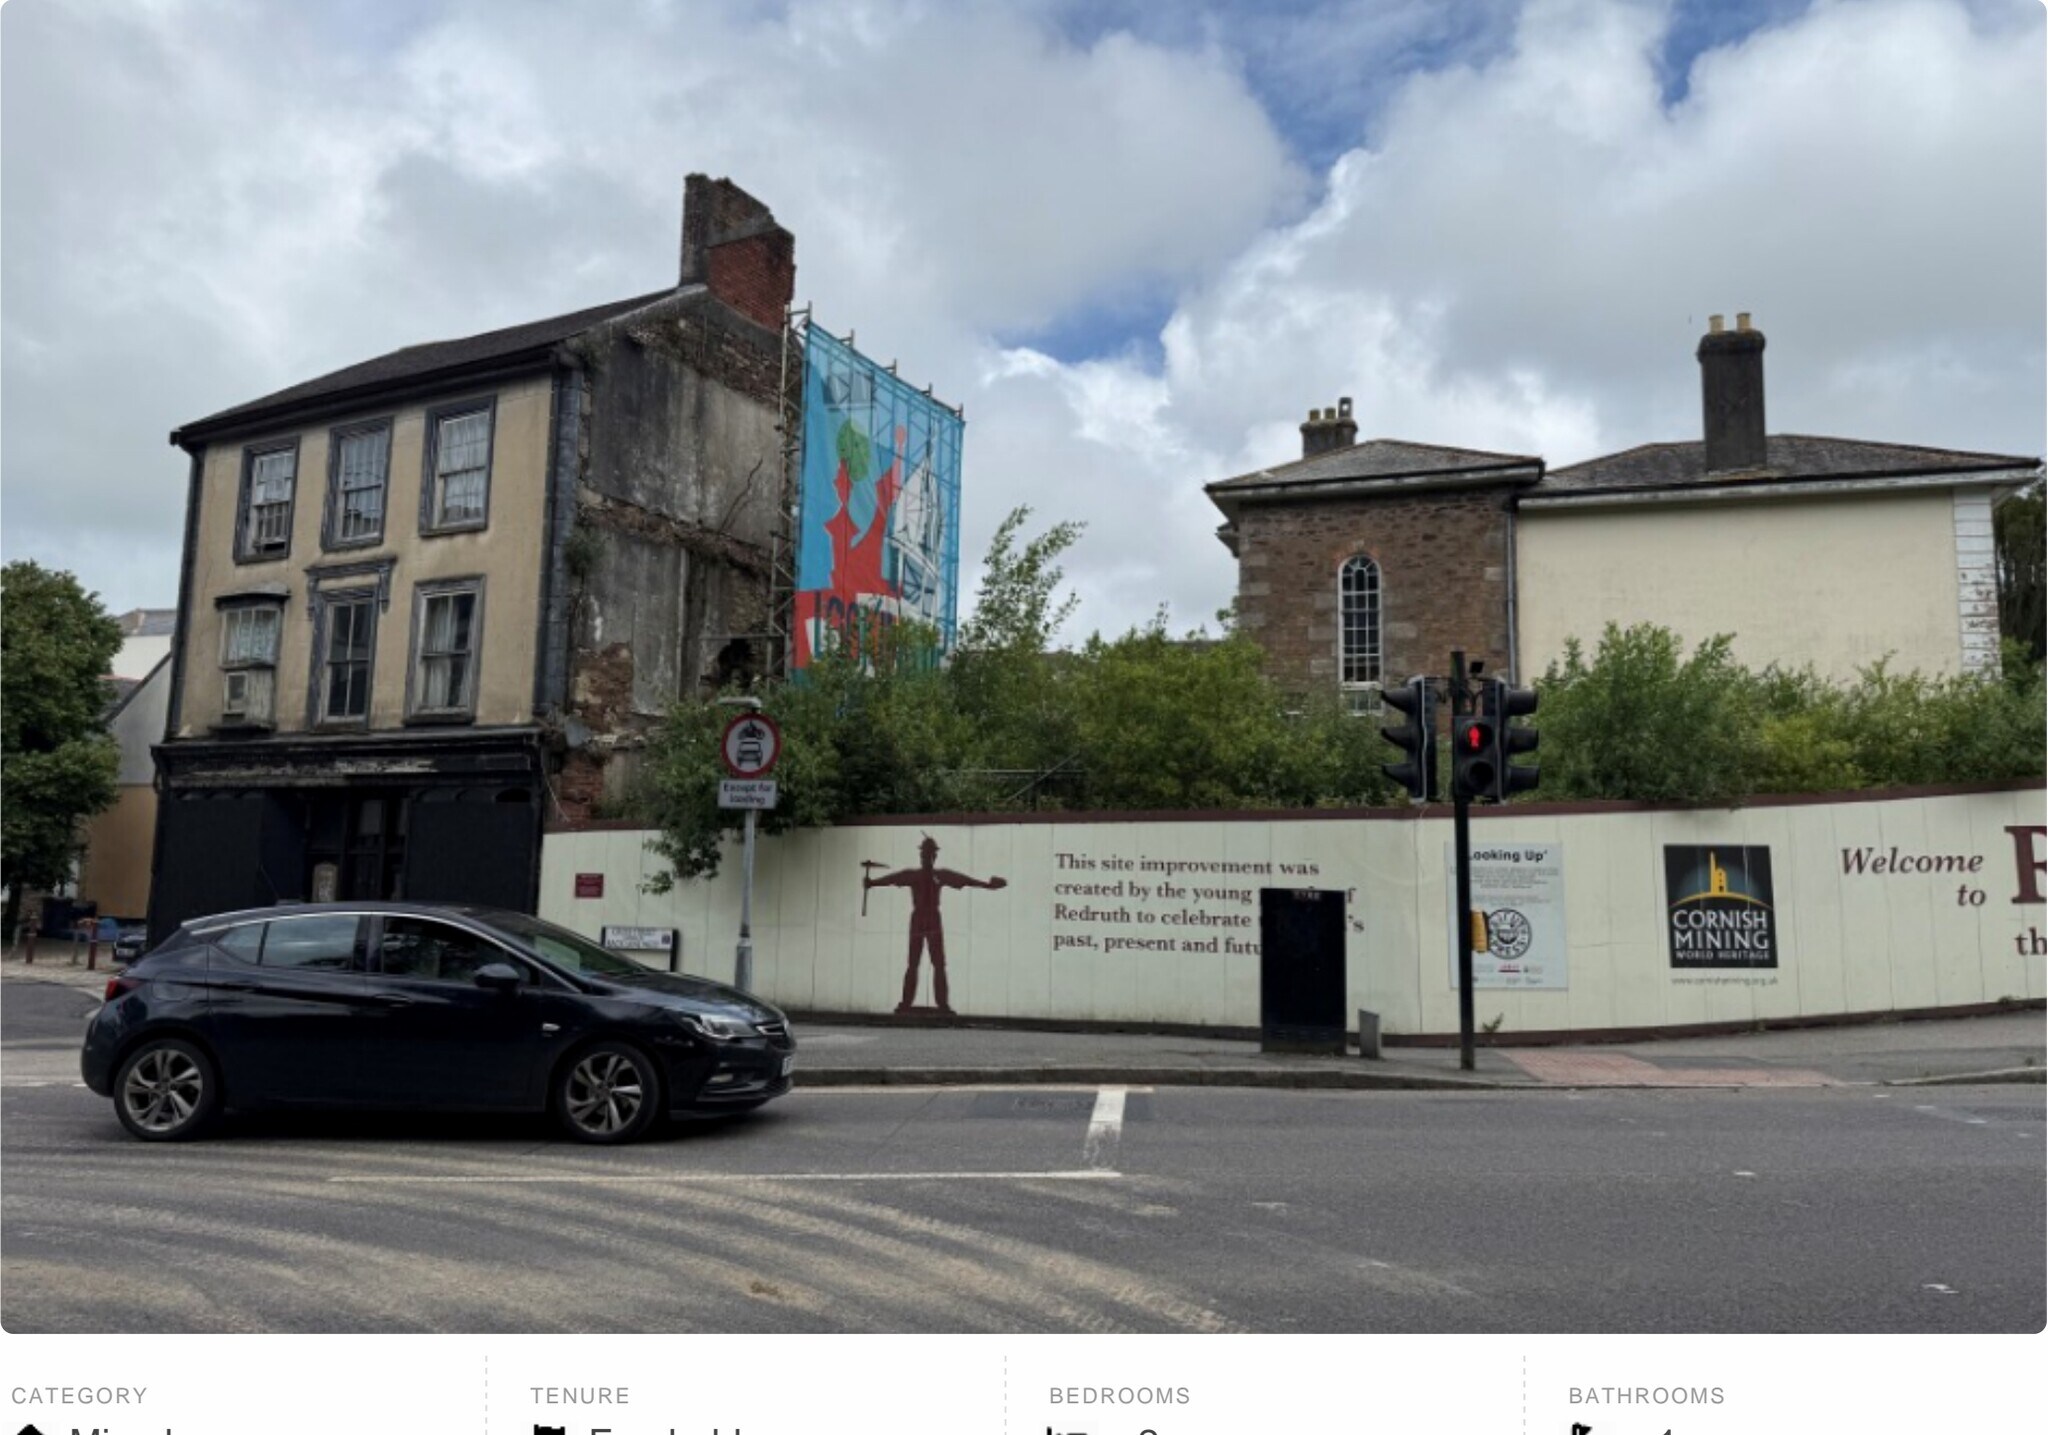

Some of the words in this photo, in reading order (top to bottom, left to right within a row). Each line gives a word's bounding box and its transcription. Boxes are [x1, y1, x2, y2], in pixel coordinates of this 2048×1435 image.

[1055, 852, 1096, 871] This
[1101, 854, 1134, 871] site
[1140, 855, 1272, 876] improvement
[1280, 862, 1320, 876] was
[1467, 849, 1521, 863] ooking
[1841, 847, 1984, 875] Welcome
[1055, 880, 1124, 898] created
[1128, 881, 1151, 902] by
[1156, 881, 1187, 899] the
[1193, 887, 1253, 905] young
[1957, 884, 1987, 907] to
[1054, 903, 1131, 924] Redruth
[1136, 910, 1156, 924] to
[1161, 908, 1253, 928] celebrate
[1673, 909, 1768, 930] CORNISH
[1053, 934, 1099, 951] past,
[1104, 936, 1177, 953] present
[1181, 937, 1219, 954] and
[1674, 930, 1770, 950] MINING
[1675, 949, 1714, 960] WORLD
[1717, 949, 1770, 960] HERITAGE
